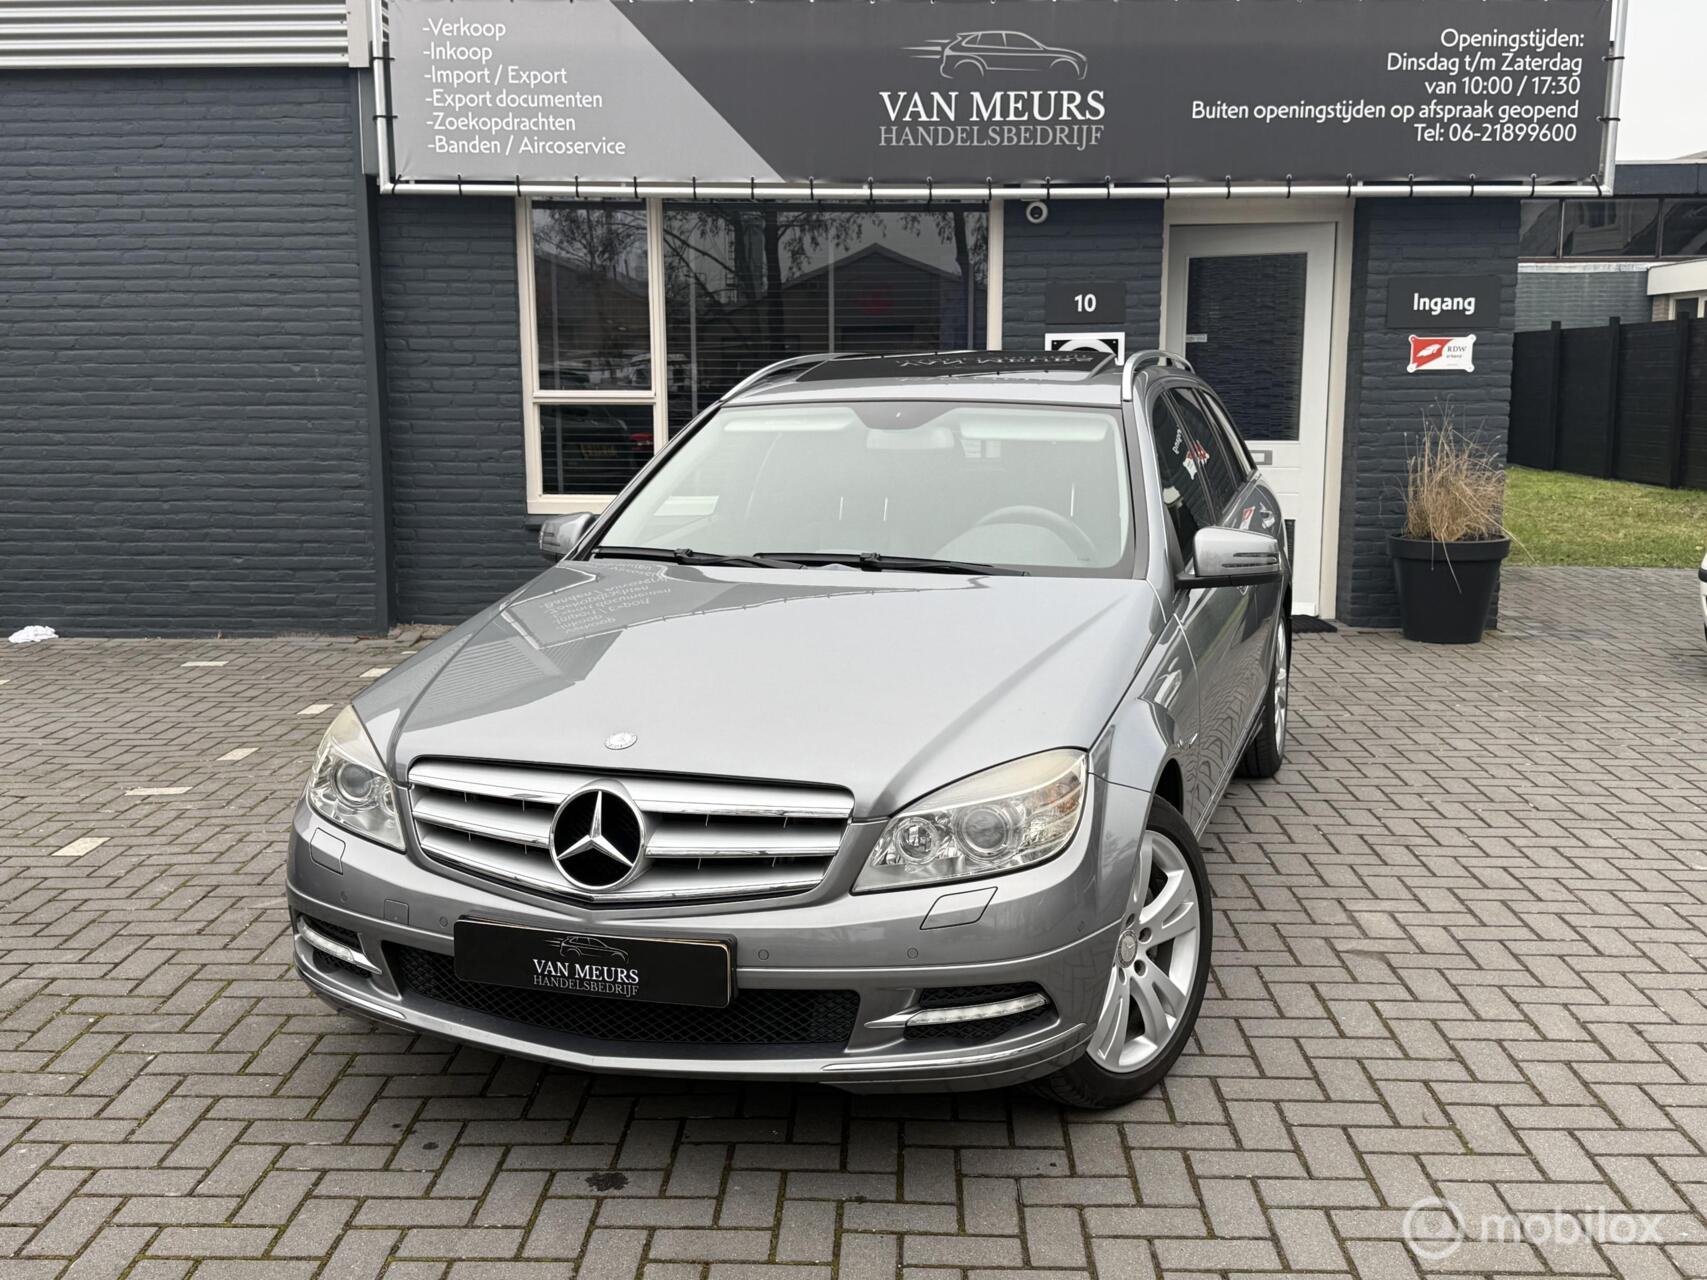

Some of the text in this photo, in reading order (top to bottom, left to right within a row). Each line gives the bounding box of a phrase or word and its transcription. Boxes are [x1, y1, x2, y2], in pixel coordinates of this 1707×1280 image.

[1440, 28, 1585, 51] Openingstijden:
[1387, 52, 1583, 75] Dinsdag t/m Zaterdag
[494, 65, 503, 85] /
[507, 66, 568, 87] Export
[1424, 76, 1581, 96] van 10:00 / 17:30
[495, 89, 603, 107] documenten
[879, 90, 1106, 121] VAN MEURS
[1192, 100, 1579, 123] Buiten openingstijden op afspraak geopend
[879, 125, 1105, 150] HANDELSBEDRIJF
[1413, 123, 1577, 141] Tel: 06-21899600
[505, 135, 514, 155] /
[518, 137, 626, 155] Aircoservice
[1074, 294, 1097, 312] 10
[1413, 293, 1476, 315] Ingang
[1447, 345, 1467, 353] RDW
[533, 959, 640, 984] VAN MEURS
[533, 975, 640, 997] HANDELSBEDRIJF
